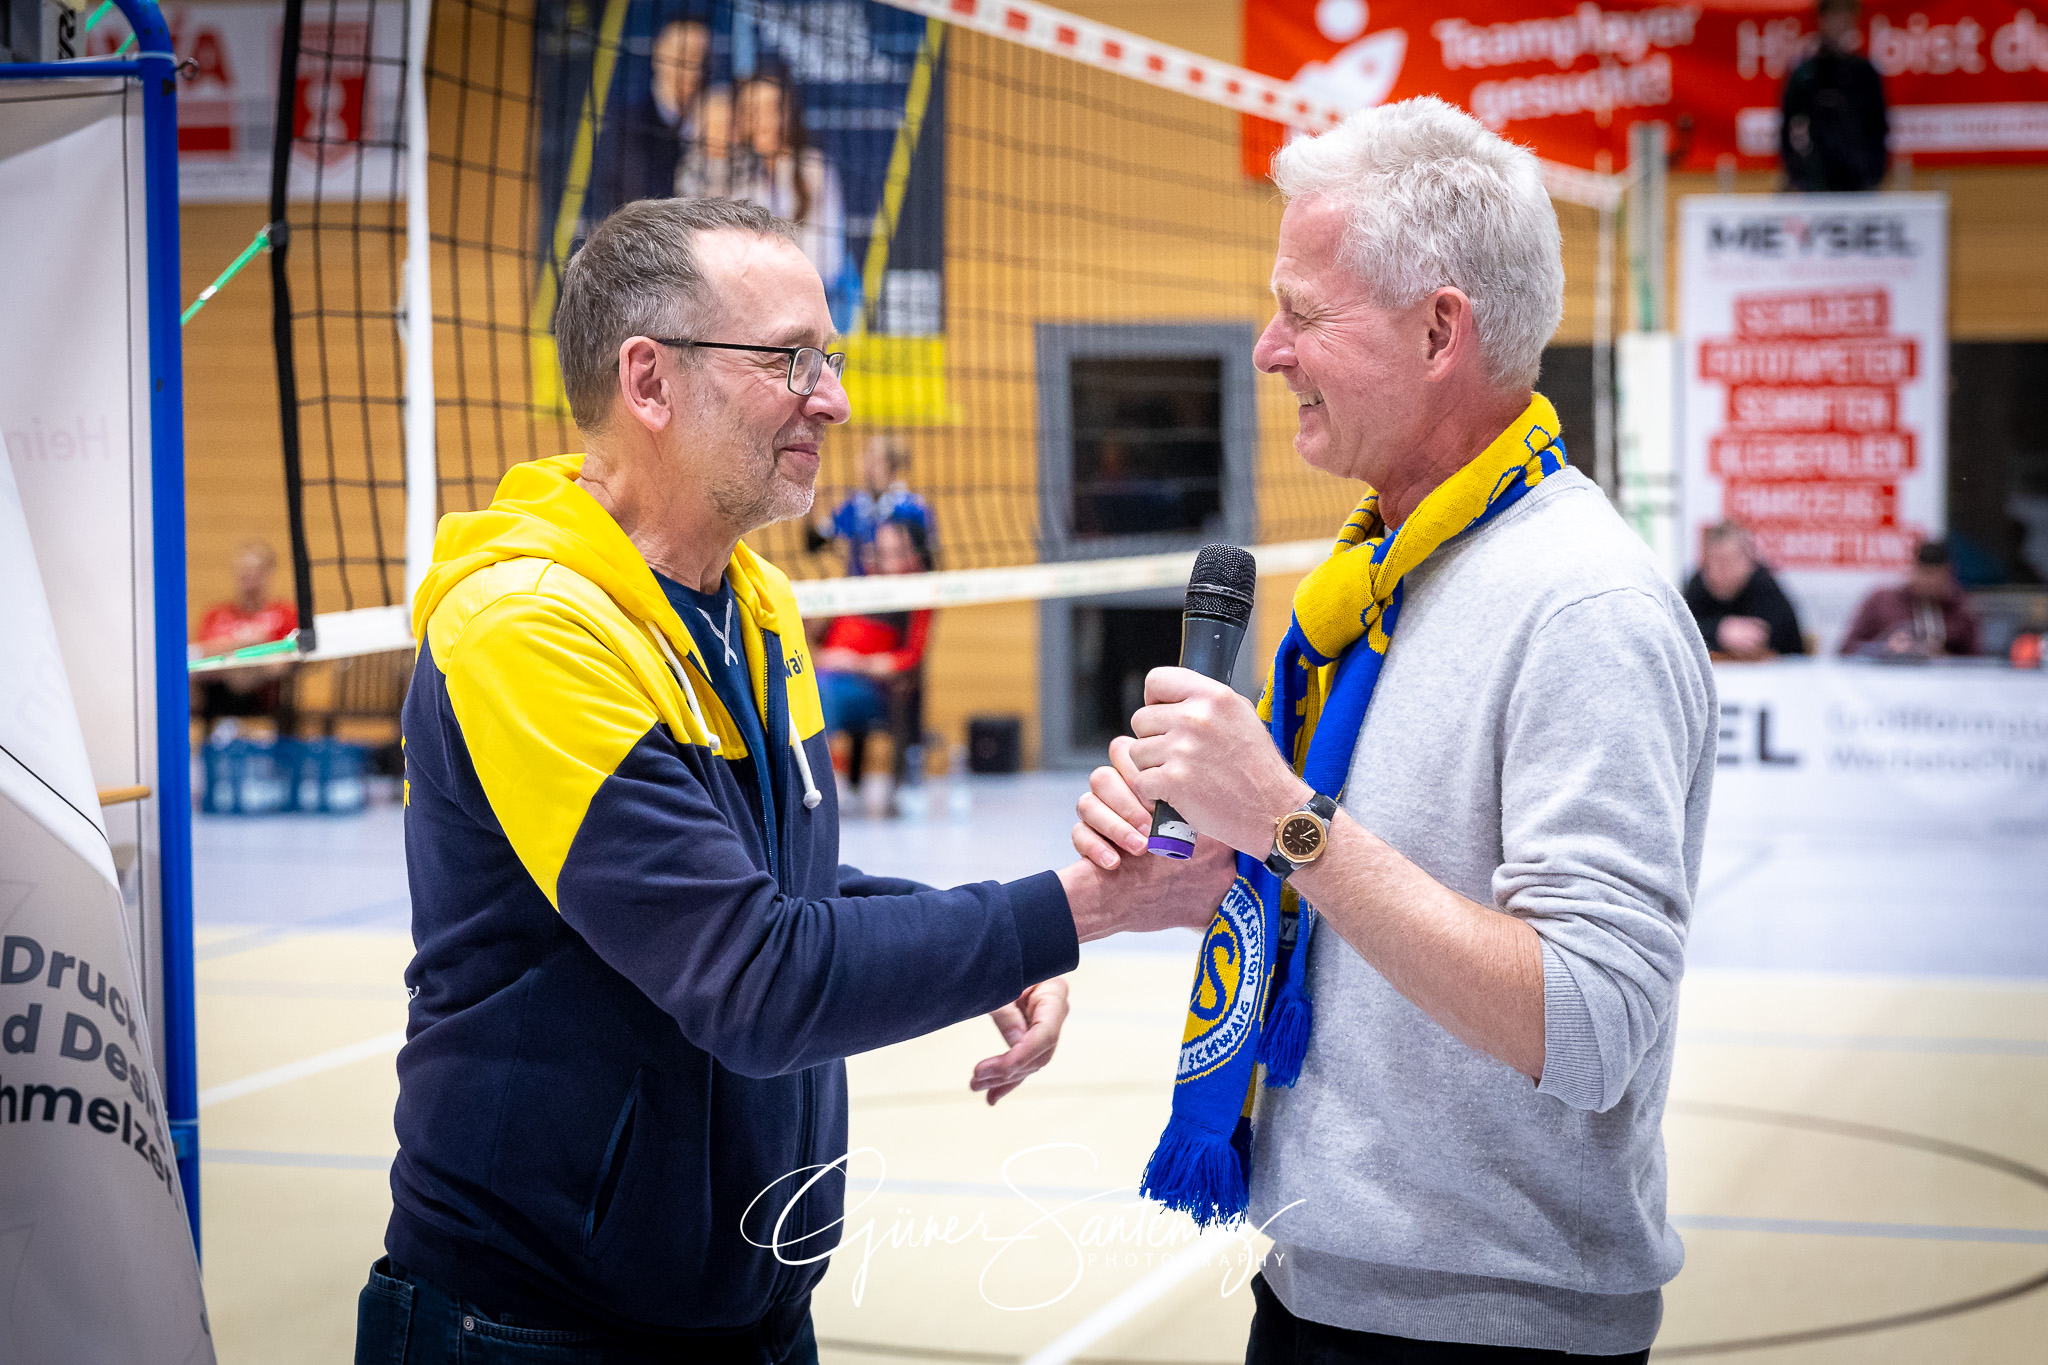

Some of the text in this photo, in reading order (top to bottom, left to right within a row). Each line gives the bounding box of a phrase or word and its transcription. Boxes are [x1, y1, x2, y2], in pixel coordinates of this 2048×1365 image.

[1431, 3, 1701, 69] Teamplayer
[1869, 12, 1986, 77] bist
[1706, 216, 1919, 258] MEYSEL
